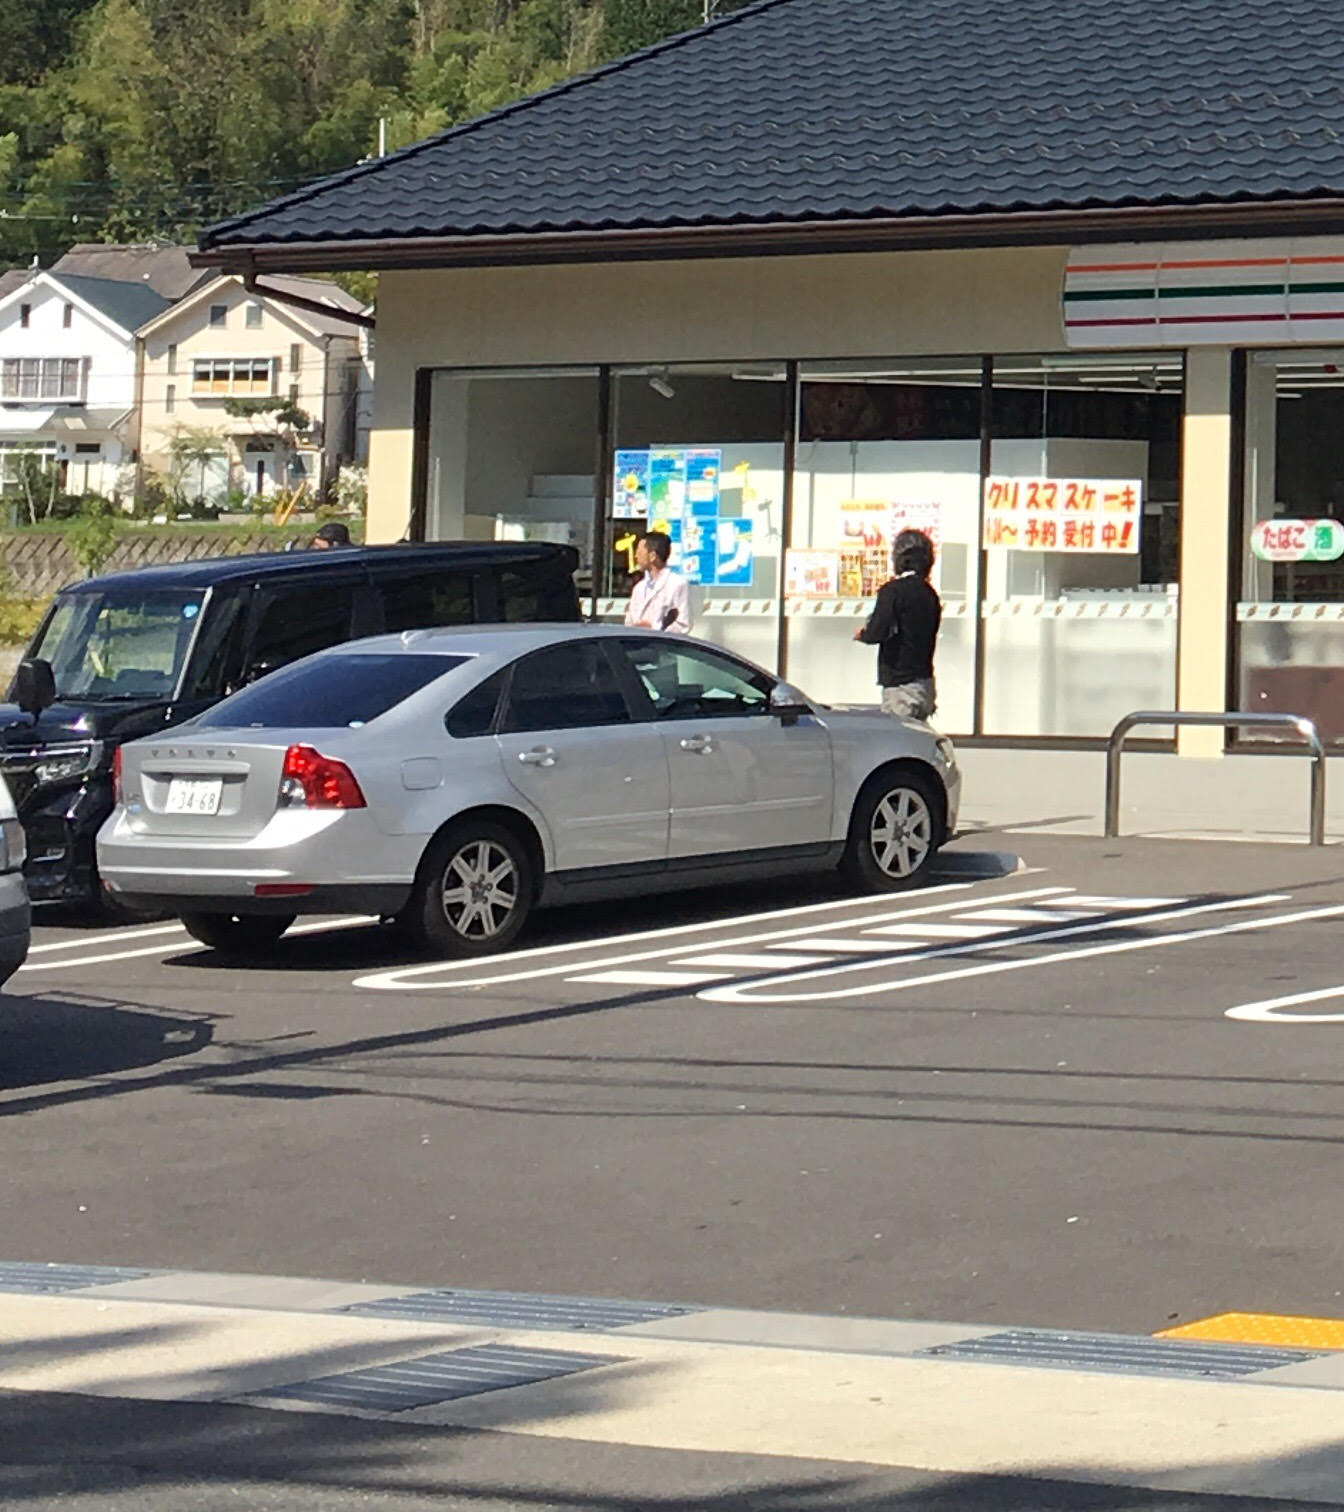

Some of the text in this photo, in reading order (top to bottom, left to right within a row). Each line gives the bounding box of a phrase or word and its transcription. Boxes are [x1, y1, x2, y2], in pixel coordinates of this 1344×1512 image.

[988, 481, 1136, 513] クリスマスケーキ
[1263, 525, 1306, 550] たばこ
